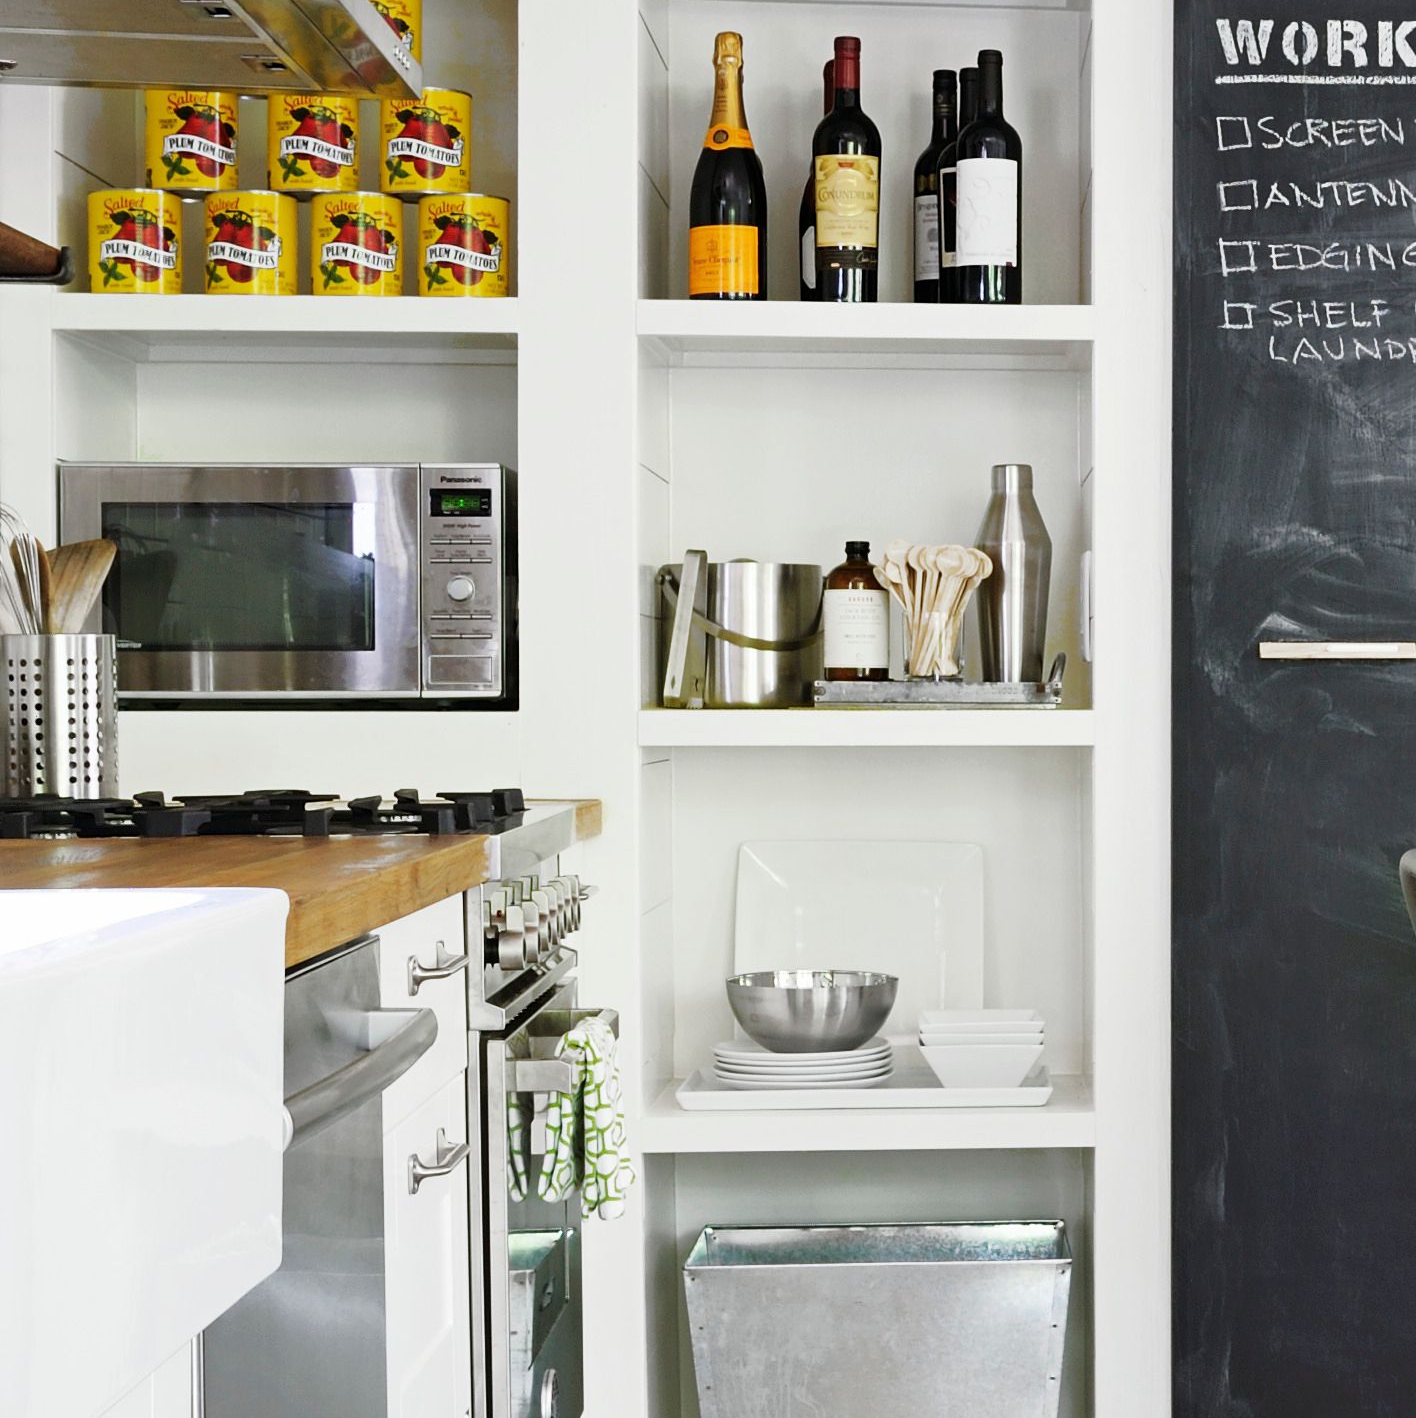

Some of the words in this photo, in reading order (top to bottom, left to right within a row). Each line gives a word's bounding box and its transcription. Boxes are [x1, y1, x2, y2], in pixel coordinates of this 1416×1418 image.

[1257, 116, 1404, 149] SCREEN
[169, 137, 195, 150] PLUM
[198, 141, 235, 163] TOMTOES
[285, 138, 309, 150] PLUM
[391, 141, 413, 153] PLUM
[103, 196, 145, 214] Salted
[429, 201, 465, 219] Salted
[105, 243, 129, 255] PLUM
[228, 247, 275, 266] TOMAOES
[326, 246, 348, 257] PLUM
[429, 247, 451, 259] PLUM
[1268, 298, 1389, 328] SHELF
[440, 476, 482, 484] Panasonic
